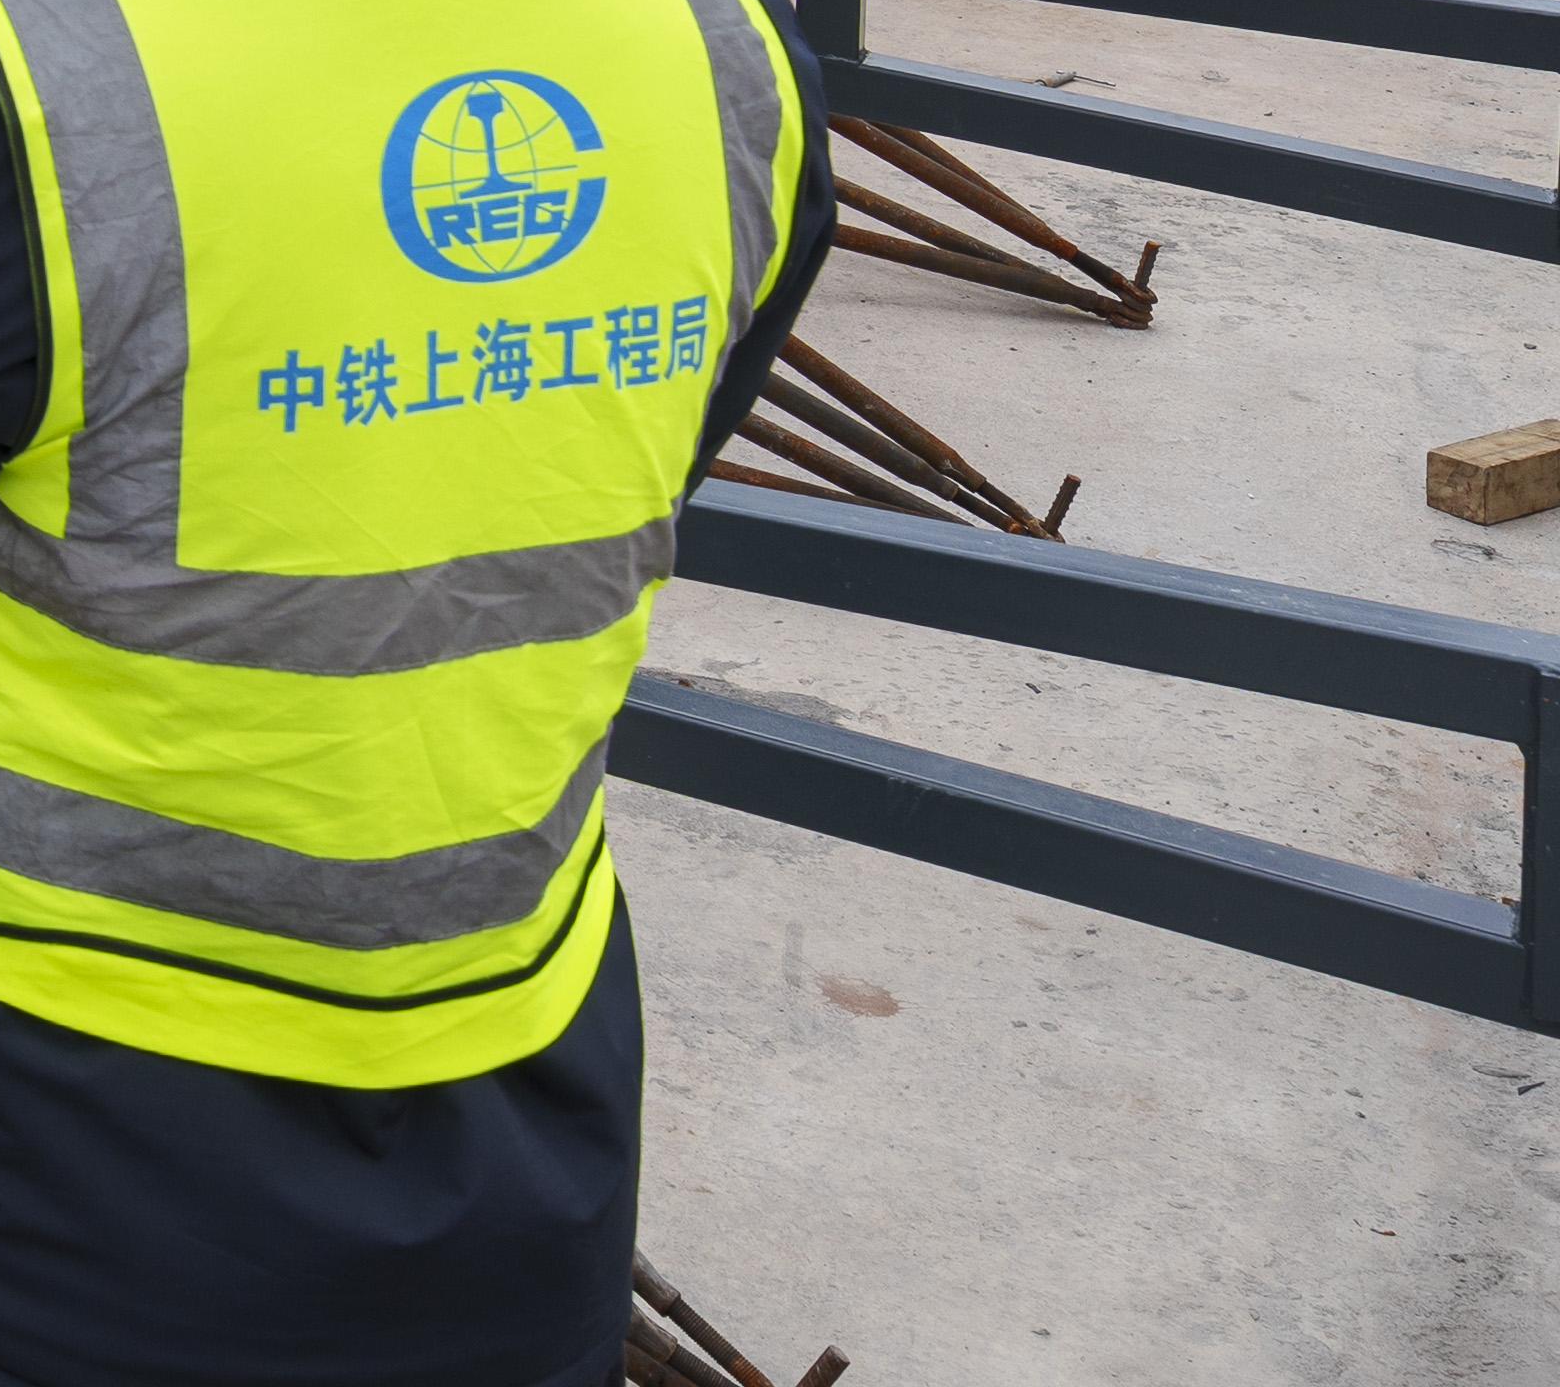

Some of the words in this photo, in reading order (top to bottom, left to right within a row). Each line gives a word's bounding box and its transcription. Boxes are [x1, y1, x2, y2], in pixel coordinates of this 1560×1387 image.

[256, 294, 709, 433] 中铁上海工程局
